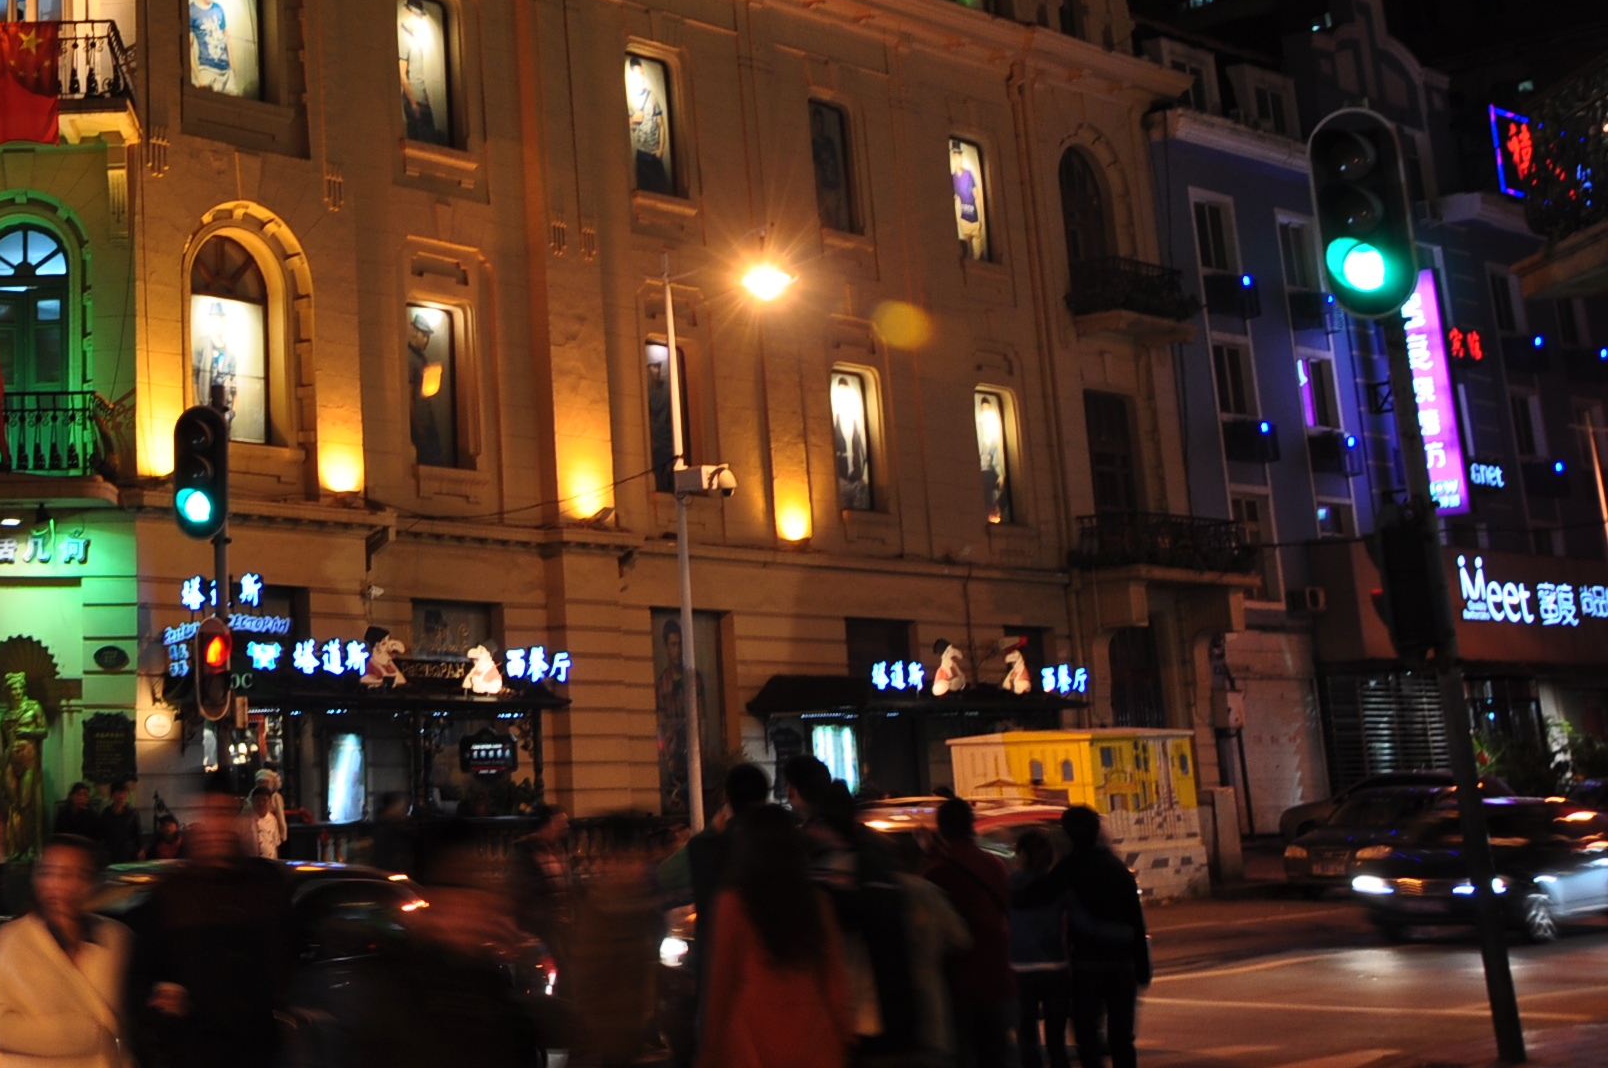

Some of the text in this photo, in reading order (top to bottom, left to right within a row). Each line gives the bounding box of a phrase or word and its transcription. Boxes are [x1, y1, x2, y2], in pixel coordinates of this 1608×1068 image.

[181, 572, 263, 610] 塔斯
[1457, 554, 1535, 624] Meet
[293, 638, 370, 676] 塔道斯
[505, 635, 571, 683] 西餐厅
[871, 660, 925, 691] 塔道斯
[1041, 663, 1089, 694] 西餐厅
